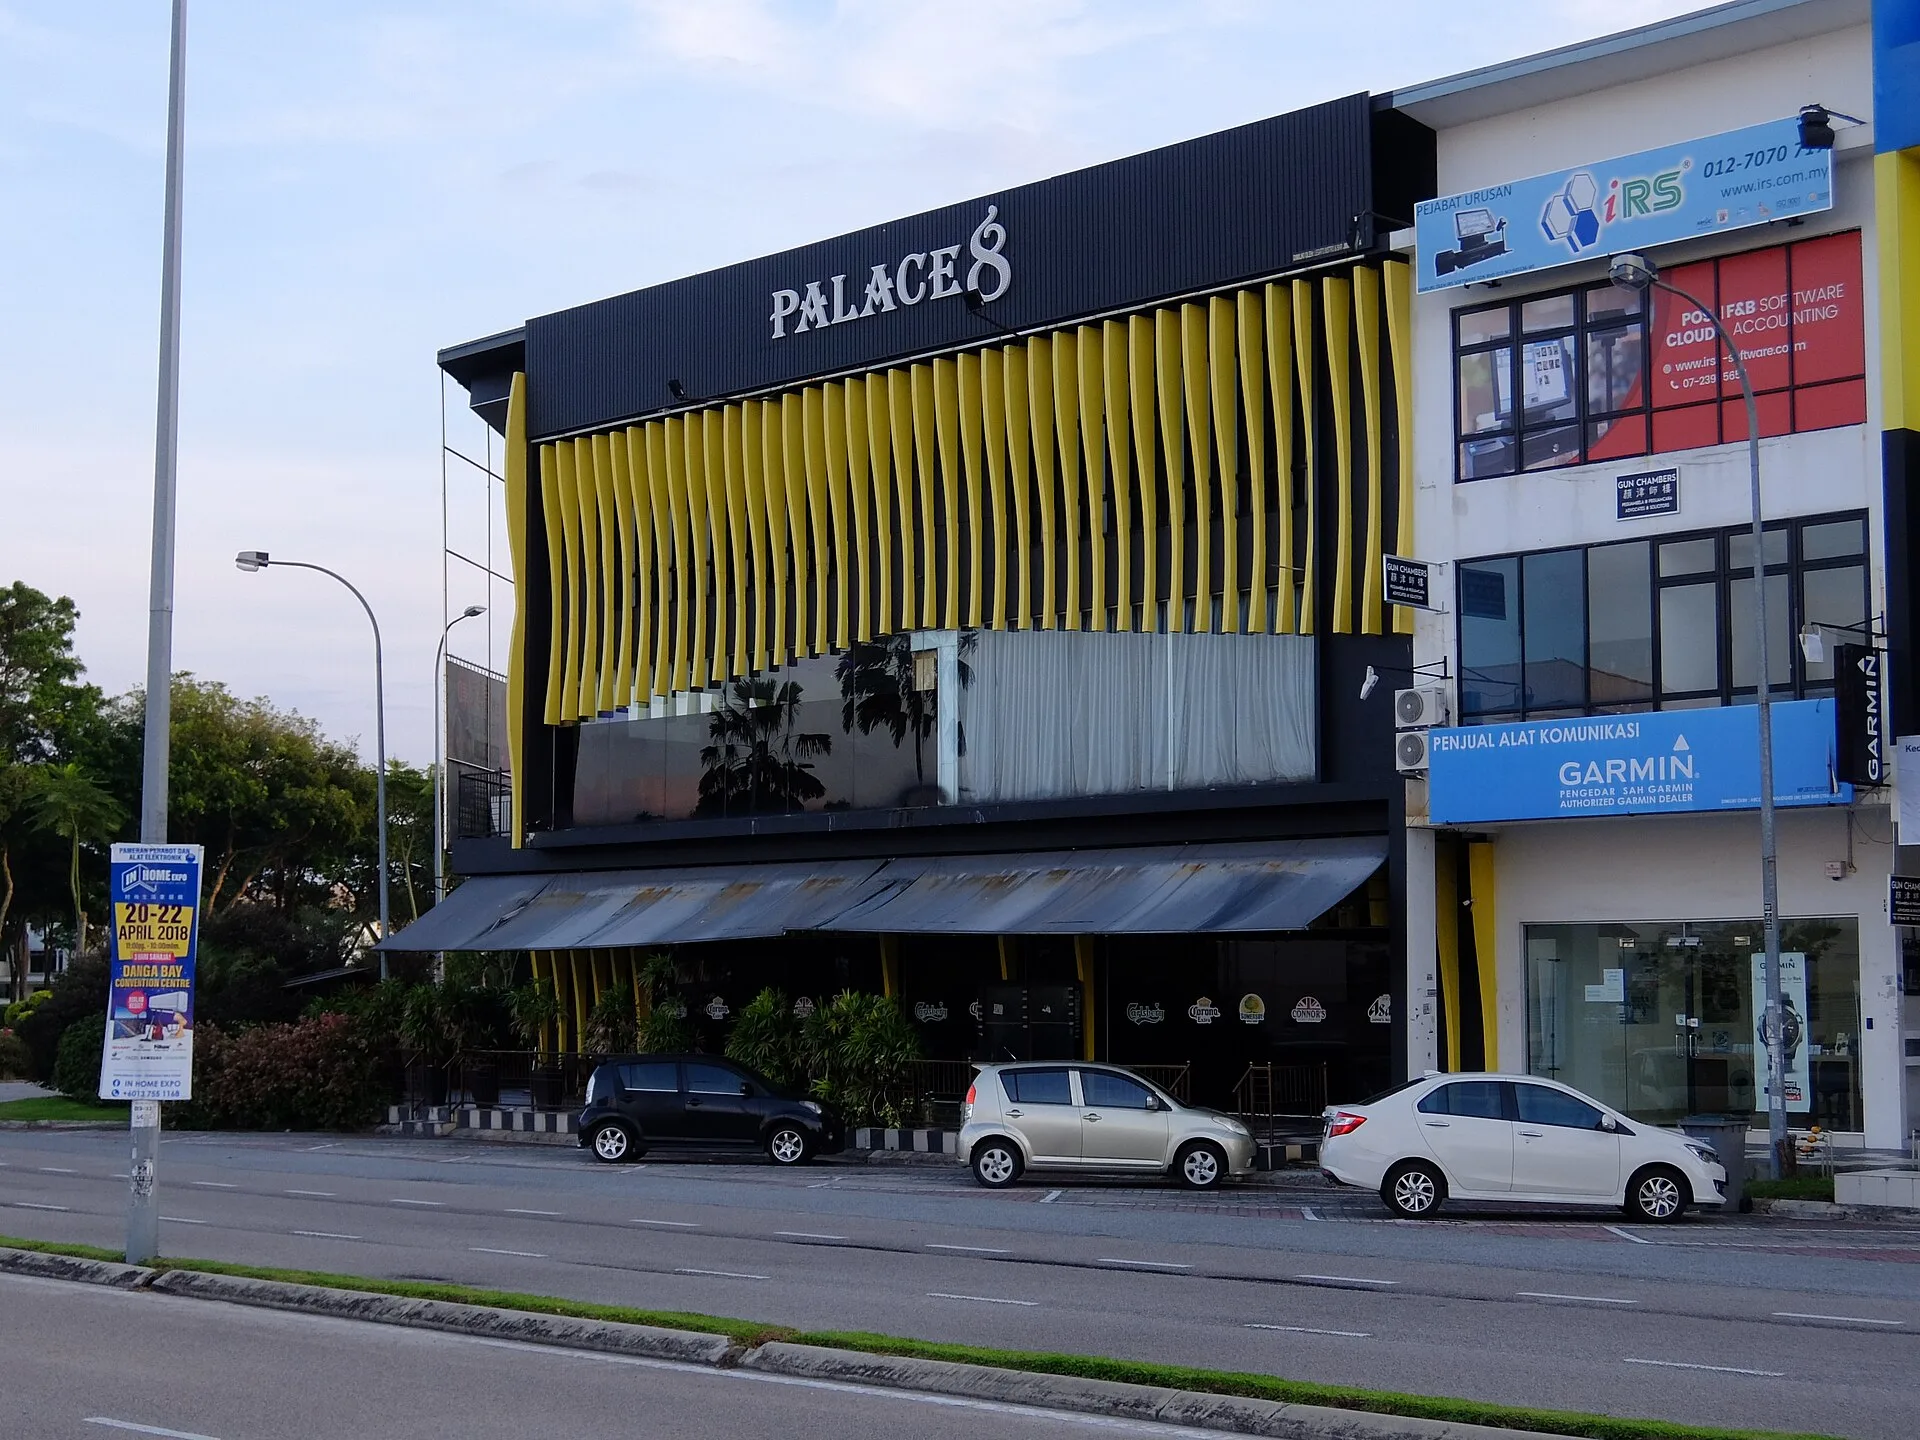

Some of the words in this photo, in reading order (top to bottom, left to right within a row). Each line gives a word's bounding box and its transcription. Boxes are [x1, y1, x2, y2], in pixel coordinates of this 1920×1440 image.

[1704, 145, 1787, 178] 012-7070
[1721, 166, 1829, 198] www.irs.com.my
[1416, 196, 1461, 216] PEJABAT
[1465, 185, 1512, 205] URUSAN
[1603, 170, 1683, 223] iRS
[769, 244, 963, 339] PALACE
[967, 204, 1011, 303] 8
[1726, 301, 1755, 318] F&B
[1760, 283, 1844, 312] SOFTWARE
[1666, 327, 1716, 347] CLOUD
[1733, 305, 1838, 336] ACCOUNTING
[1675, 341, 1807, 372] www.irs-sftware.com
[1618, 480, 1634, 489] GUN
[1636, 474, 1676, 486] CHAMBERS
[1387, 563, 1398, 571] GUN
[1866, 655, 1878, 780] GARMIN
[1433, 733, 1495, 751] PENJUAL
[1499, 730, 1535, 747] ALAT
[1540, 722, 1640, 744] KOMUNIKASI
[1559, 755, 1693, 786] GARMIN
[1560, 787, 1615, 798] PENGEDAR
[1623, 786, 1644, 795] SAH
[1648, 783, 1693, 793] GARMIN
[1560, 798, 1614, 808] AUTHORIZED
[1617, 796, 1656, 805] GARMIN
[1659, 794, 1693, 803] DEALER
[126, 870, 137, 885] IN
[143, 869, 171, 881] HOME
[172, 873, 187, 881] EXPO
[125, 903, 182, 923] 20-22
[119, 925, 154, 940] APRIL
[158, 925, 188, 940] 2018
[115, 978, 159, 987] CONVENTION
[160, 979, 190, 988] CENTRE
[123, 965, 158, 977] DANGA
[161, 965, 183, 977] BAY
[1127, 1003, 1165, 1024] Carlsberg
[1188, 1005, 1220, 1019] Corona
